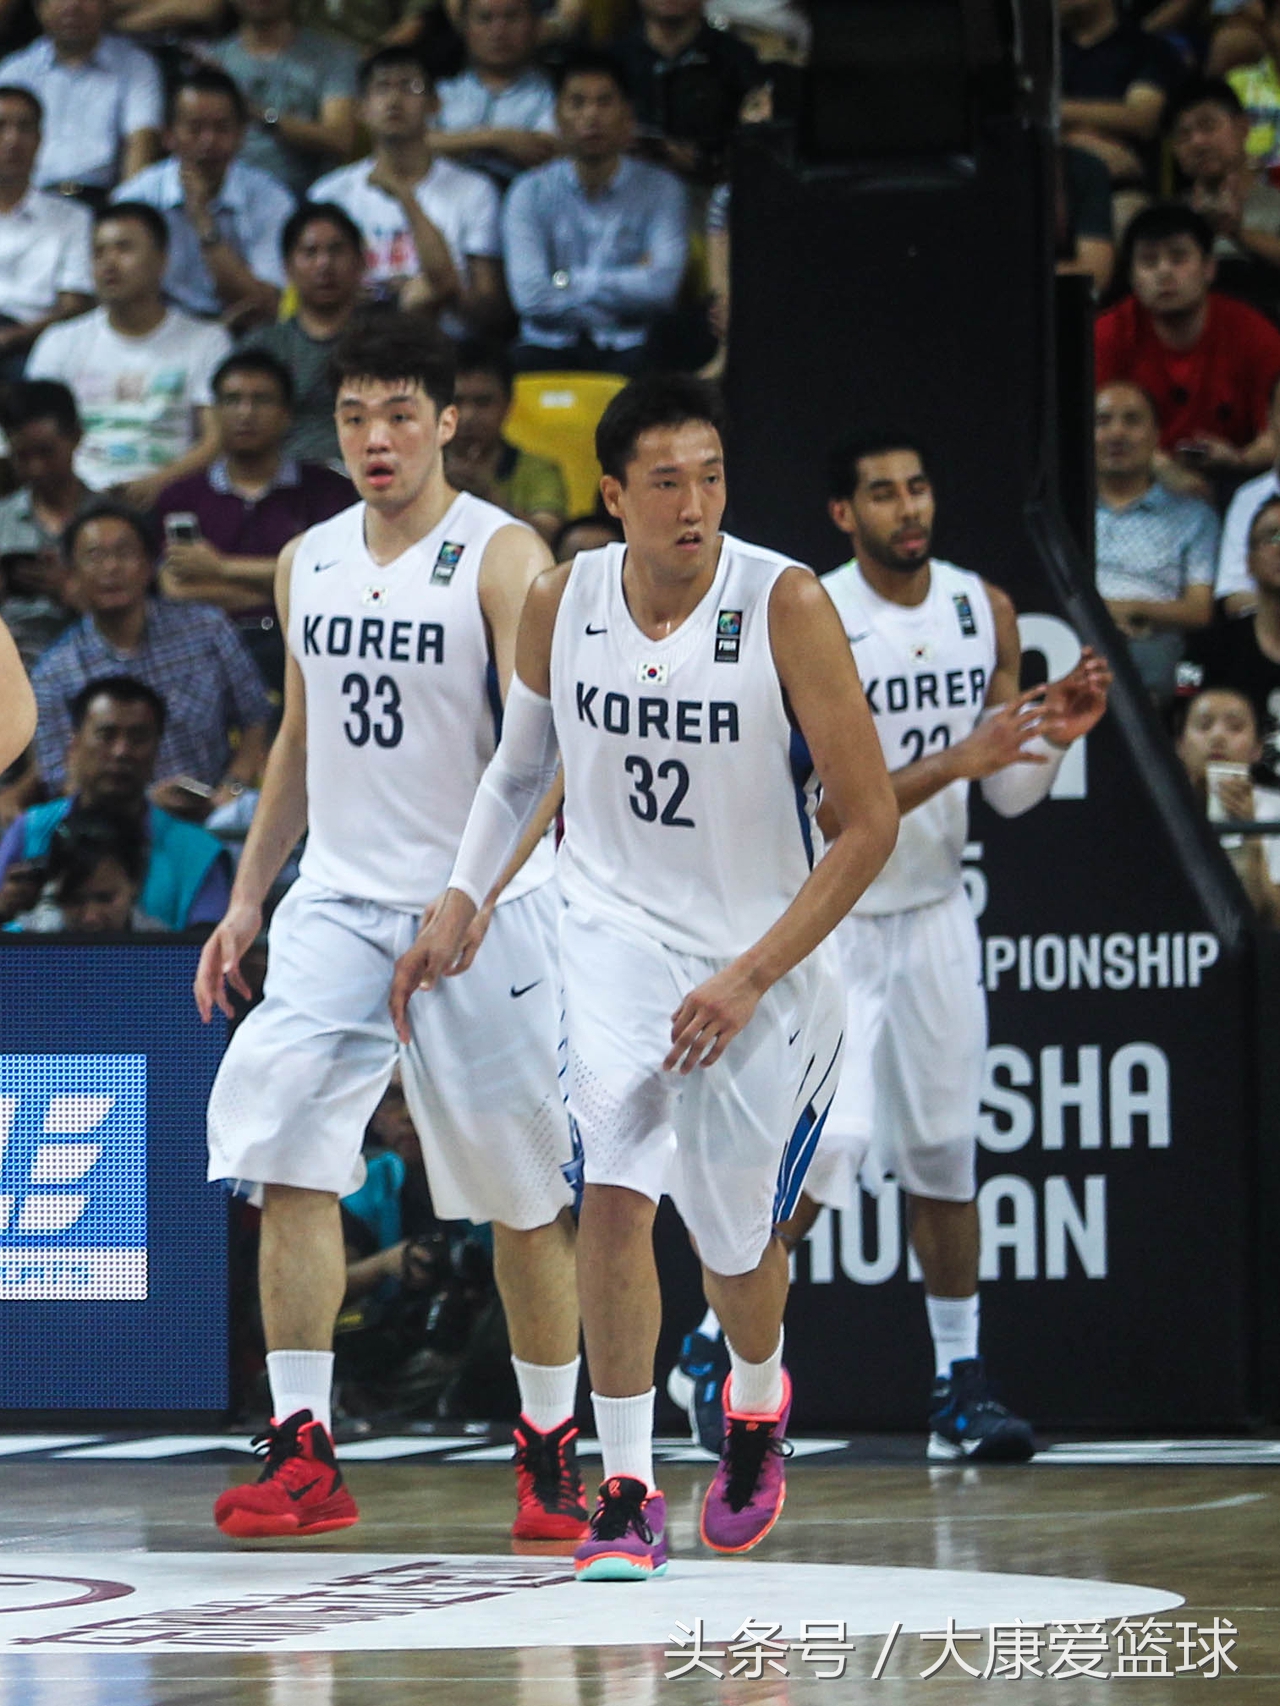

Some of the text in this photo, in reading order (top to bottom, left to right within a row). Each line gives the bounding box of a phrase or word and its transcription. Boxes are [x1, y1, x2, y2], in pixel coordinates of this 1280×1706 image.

[304, 614, 445, 665] KOREA
[342, 672, 404, 748] 33
[576, 680, 740, 745] KOREA
[624, 754, 696, 828] 32
[985, 932, 1219, 992] PIONSHIP
[975, 1042, 1171, 1154] SHA
